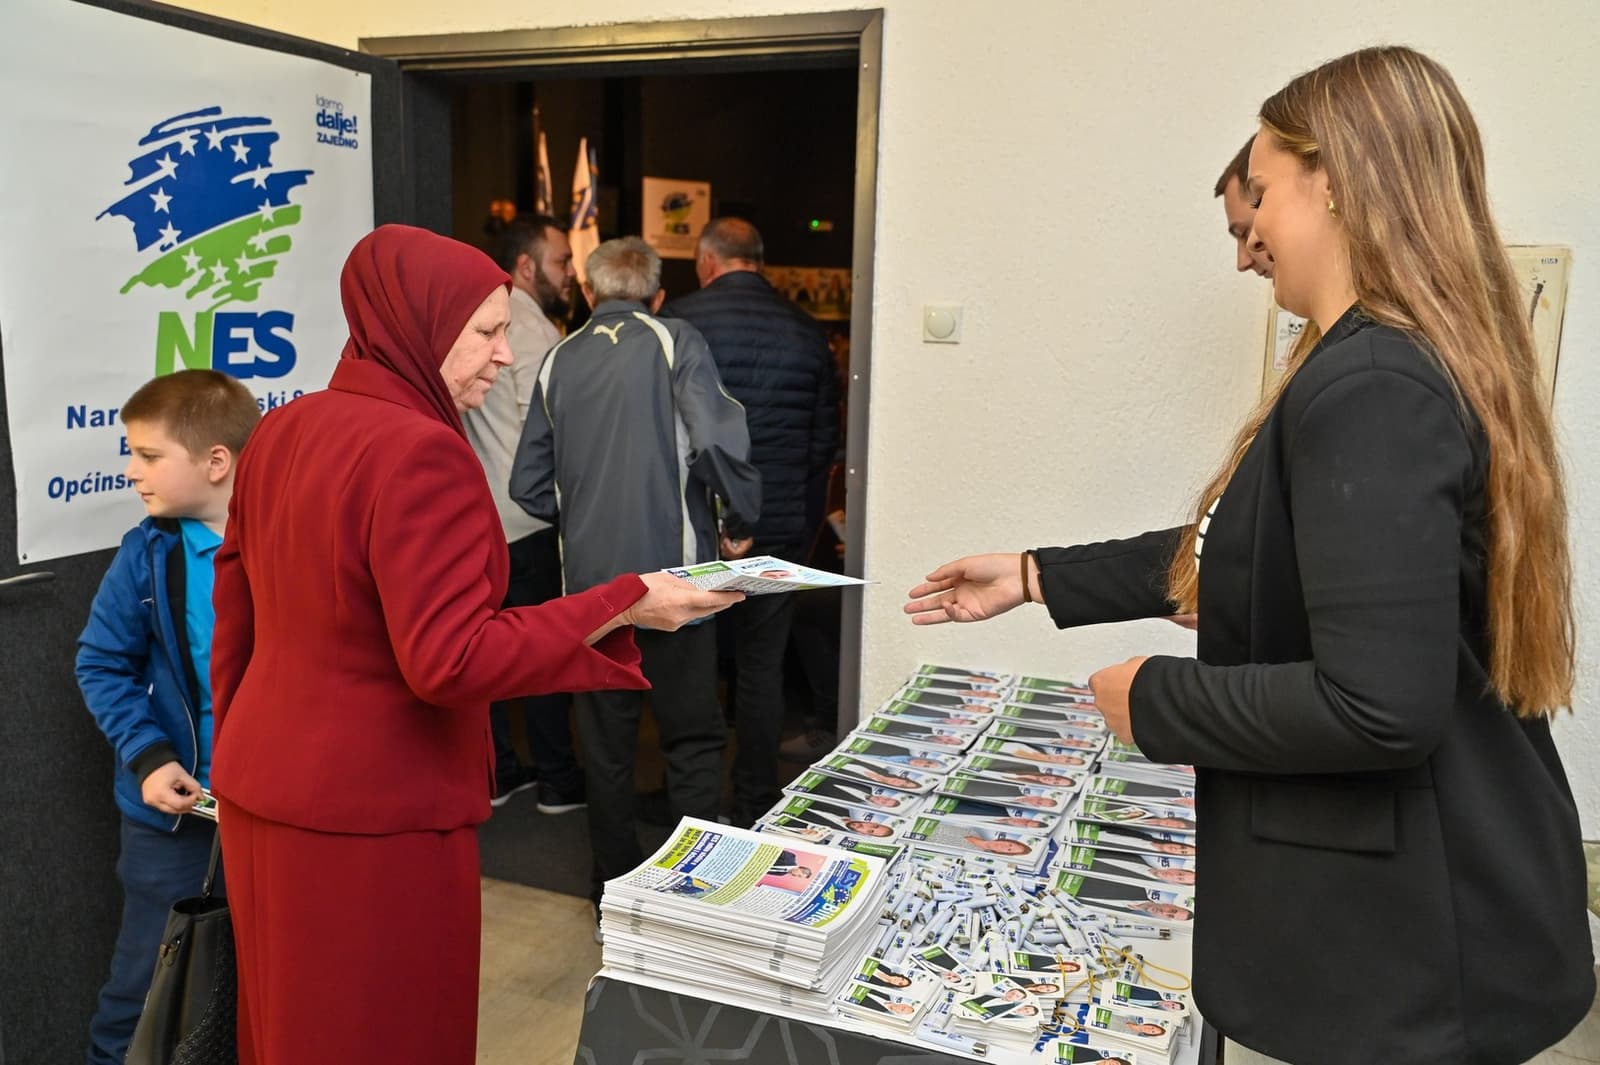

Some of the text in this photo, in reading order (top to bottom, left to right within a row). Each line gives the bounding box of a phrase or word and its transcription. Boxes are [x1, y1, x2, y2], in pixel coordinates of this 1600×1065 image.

[316, 108, 358, 136] dalje!
[316, 131, 359, 150] ZAJEDNO
[155, 310, 297, 379] NES
[66, 404, 120, 429] Nar
[800, 902, 839, 926] Bilten
